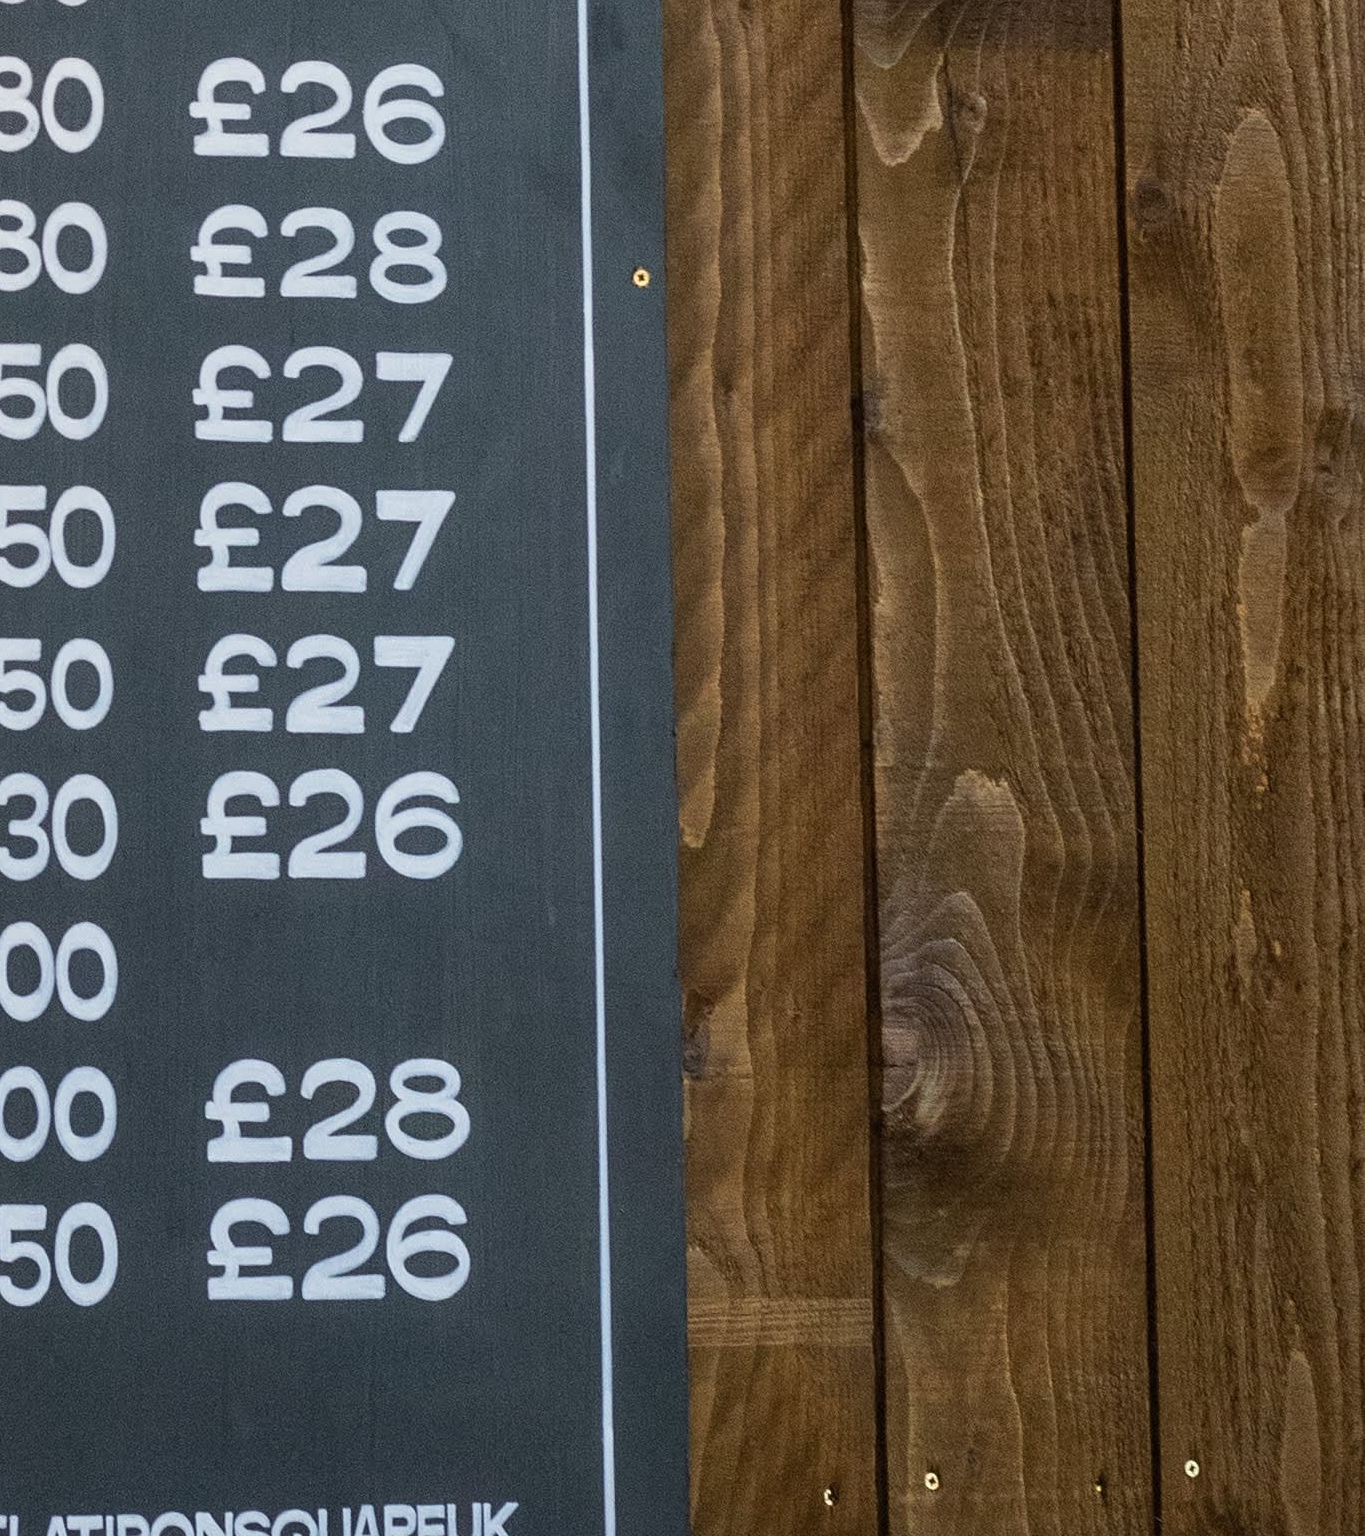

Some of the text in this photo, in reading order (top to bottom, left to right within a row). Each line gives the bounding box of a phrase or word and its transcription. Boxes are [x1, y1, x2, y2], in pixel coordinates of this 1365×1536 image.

[188, 56, 446, 165] £26
[189, 204, 448, 305] £28
[191, 344, 454, 444] £27
[193, 481, 457, 593] £27
[197, 633, 456, 734] £27
[199, 768, 464, 880] £26
[204, 1057, 471, 1163] £28
[206, 1194, 471, 1302] £26
